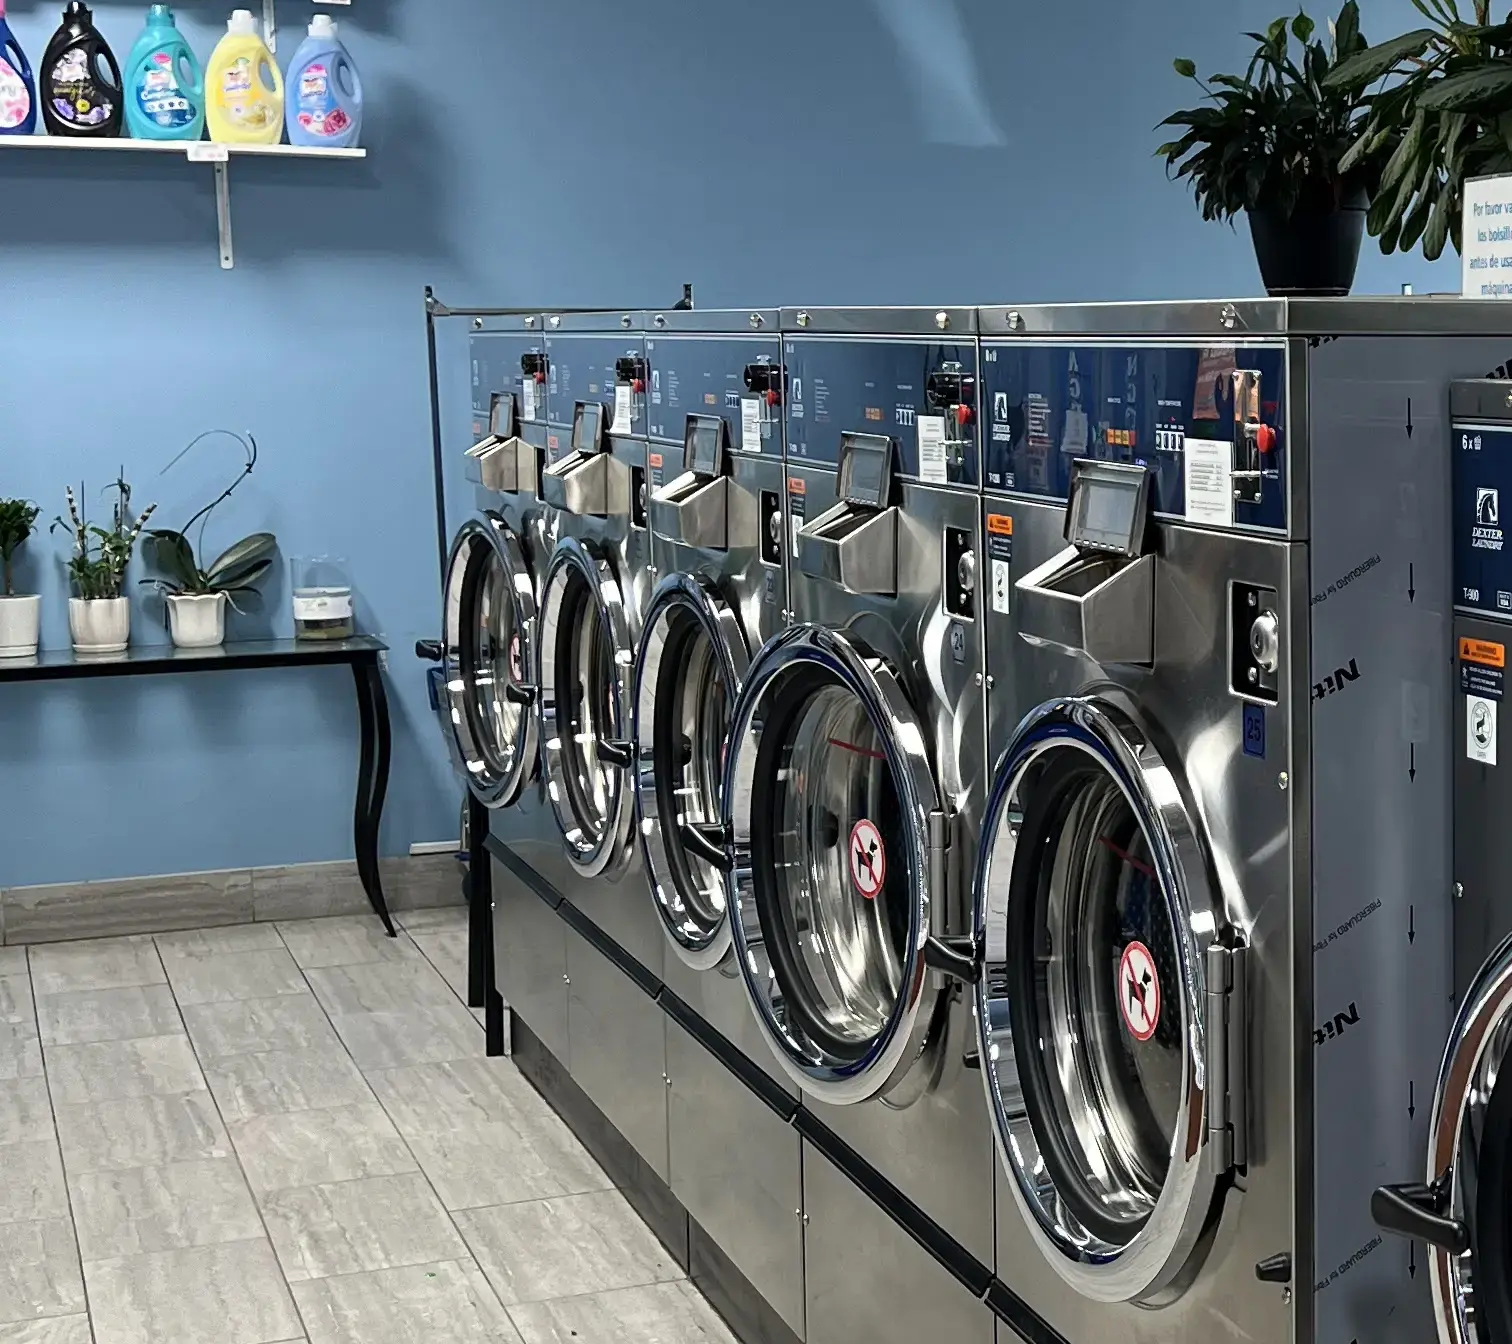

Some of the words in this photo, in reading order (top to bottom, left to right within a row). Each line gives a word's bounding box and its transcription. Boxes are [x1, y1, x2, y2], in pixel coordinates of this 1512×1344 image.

[1472, 526, 1504, 541] DEXTER
[1246, 716, 1262, 742] 25
[1312, 1002, 1362, 1046] Nit
